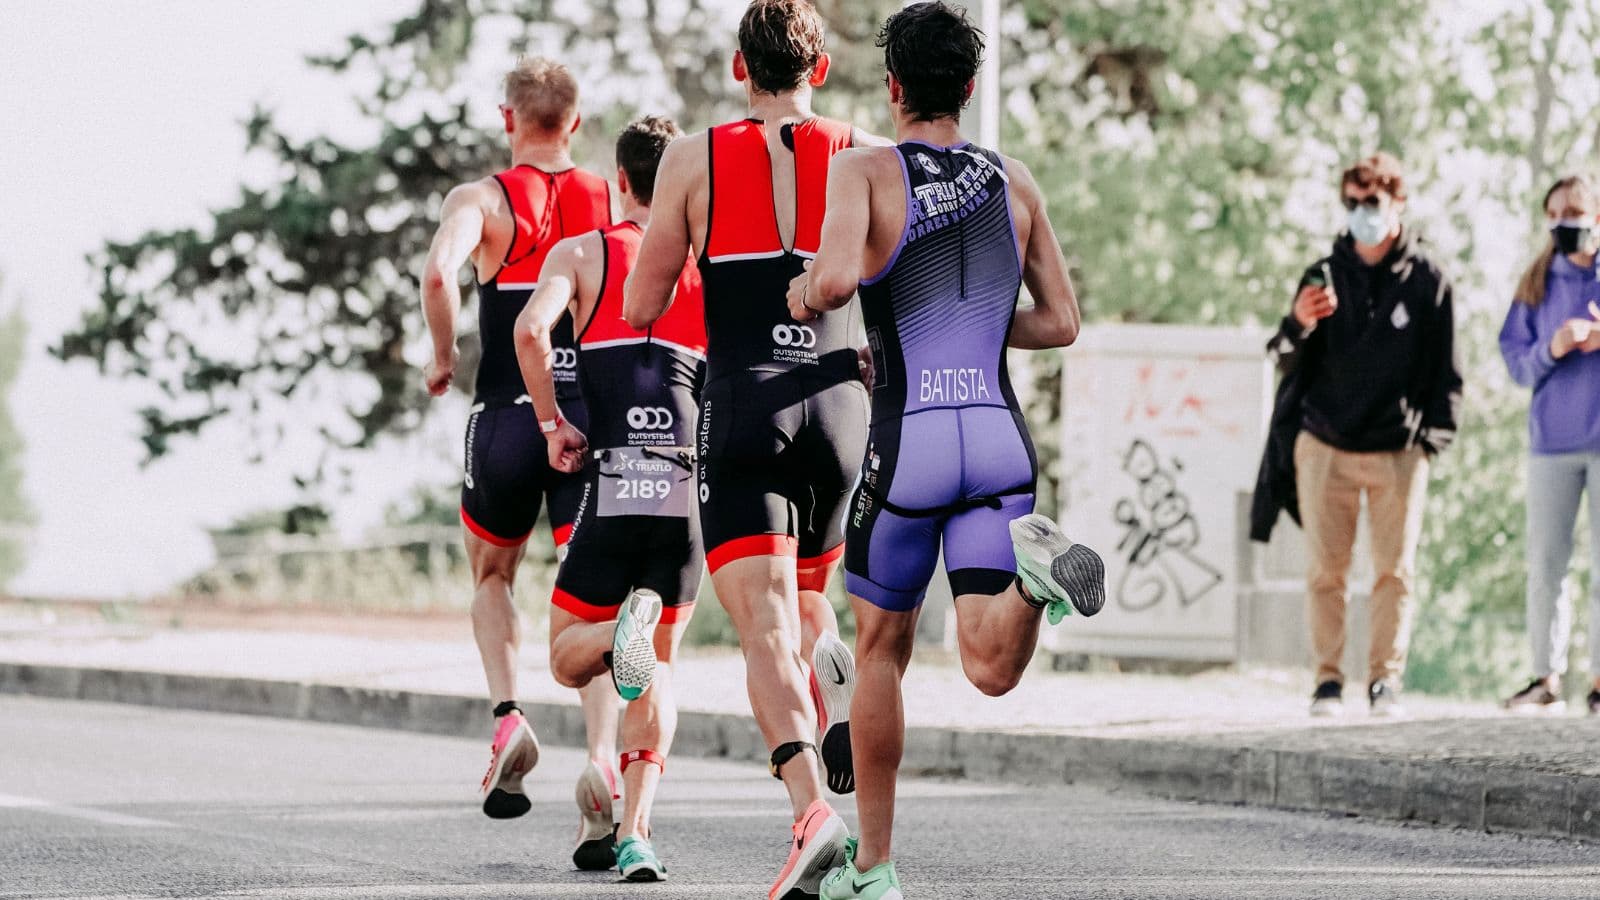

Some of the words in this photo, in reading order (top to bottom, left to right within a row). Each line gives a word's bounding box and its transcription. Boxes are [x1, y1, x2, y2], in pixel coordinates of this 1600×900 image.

[773, 349, 818, 359] OUTSYSTEMS
[920, 368, 991, 402] BATISTA
[628, 432, 675, 440] OUTSYSTEMS
[700, 400, 712, 480] ousystems
[636, 463, 673, 472] TRIATLO
[615, 479, 671, 500] 2189
[854, 469, 871, 528] FILSTE
